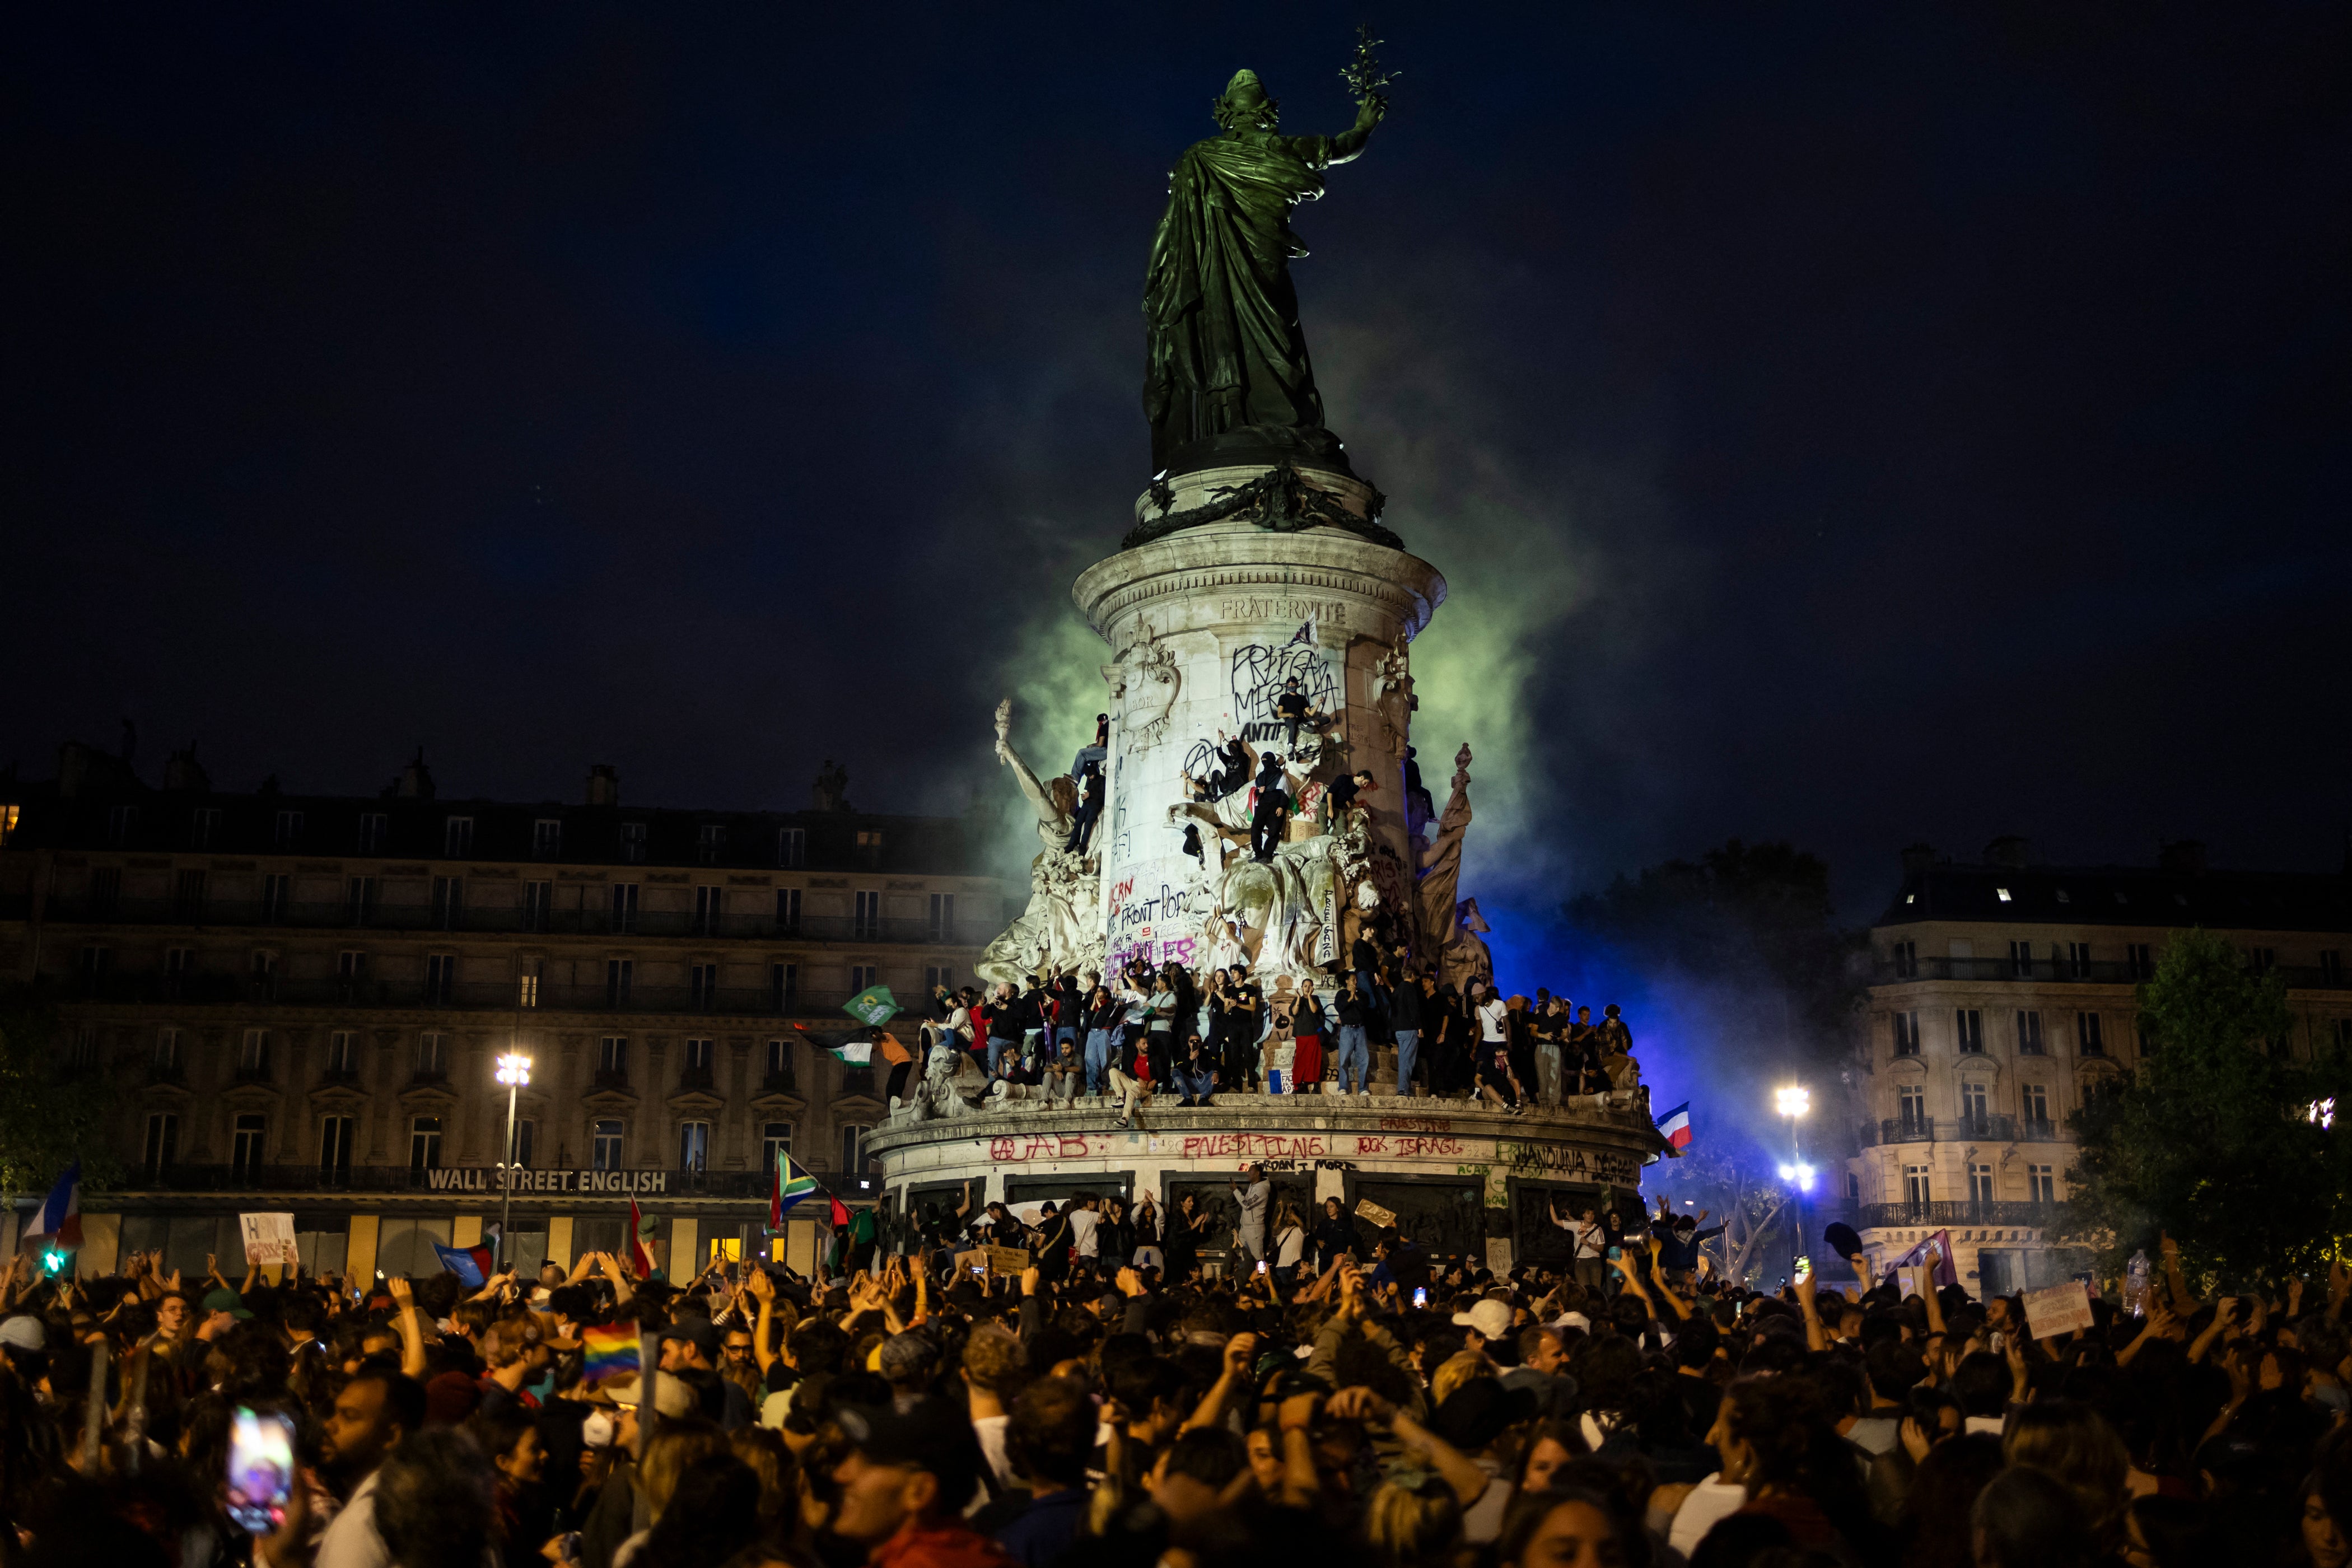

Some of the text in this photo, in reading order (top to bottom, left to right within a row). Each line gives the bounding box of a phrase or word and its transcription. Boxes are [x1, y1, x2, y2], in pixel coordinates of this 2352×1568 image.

[1239, 722, 1287, 743] ANTIF
[1184, 1132, 1324, 1159] PALESTINE
[428, 1169, 666, 1192] WALL STREET ENGLISH
